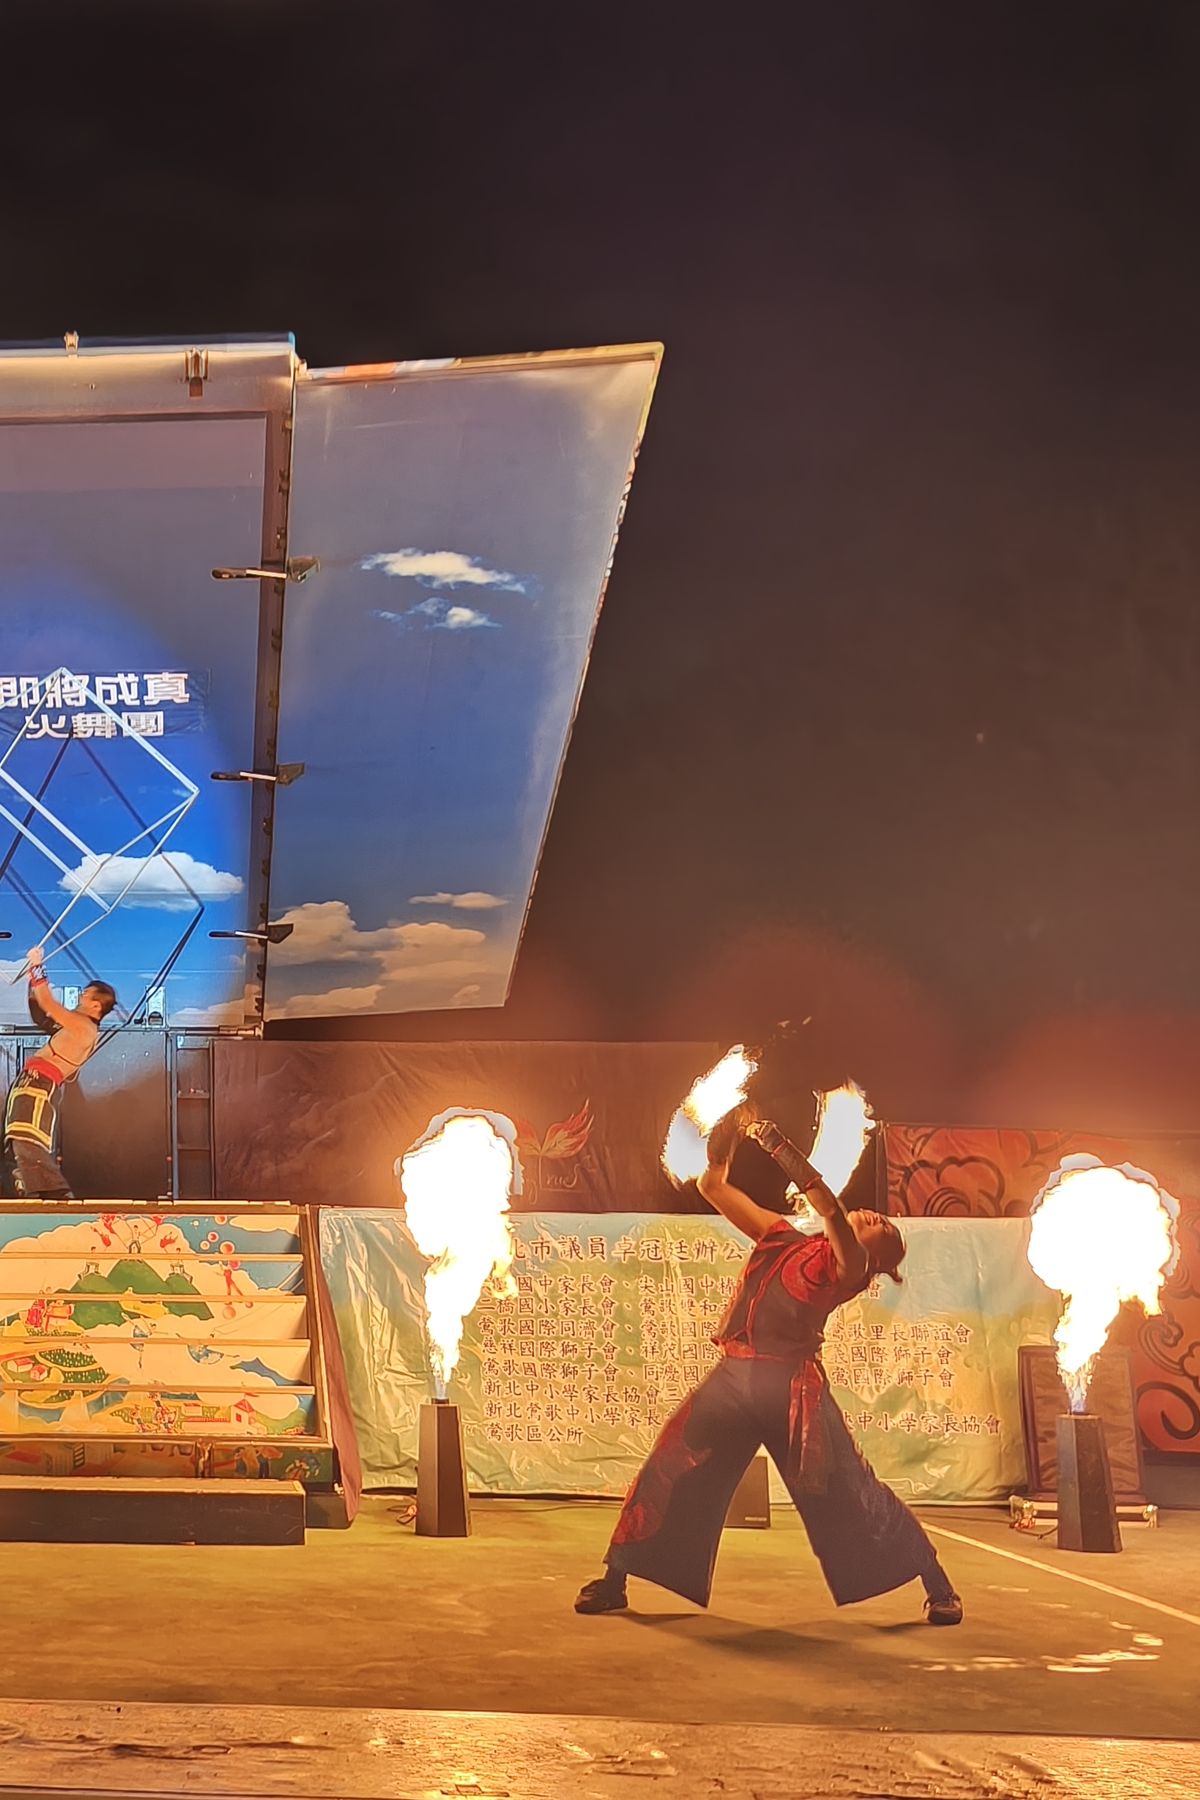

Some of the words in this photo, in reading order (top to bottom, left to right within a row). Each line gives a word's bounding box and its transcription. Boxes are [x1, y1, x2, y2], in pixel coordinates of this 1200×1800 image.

[25, 711, 164, 739] 火舞團
[511, 1236, 752, 1263] 北市議員卓冠廷辦公
[483, 1273, 734, 1298] 國中家長會、尖山國中
[486, 1380, 698, 1405] 新北中小學家長協會三
[487, 1401, 676, 1427] 新北鶯歌中小學家長
